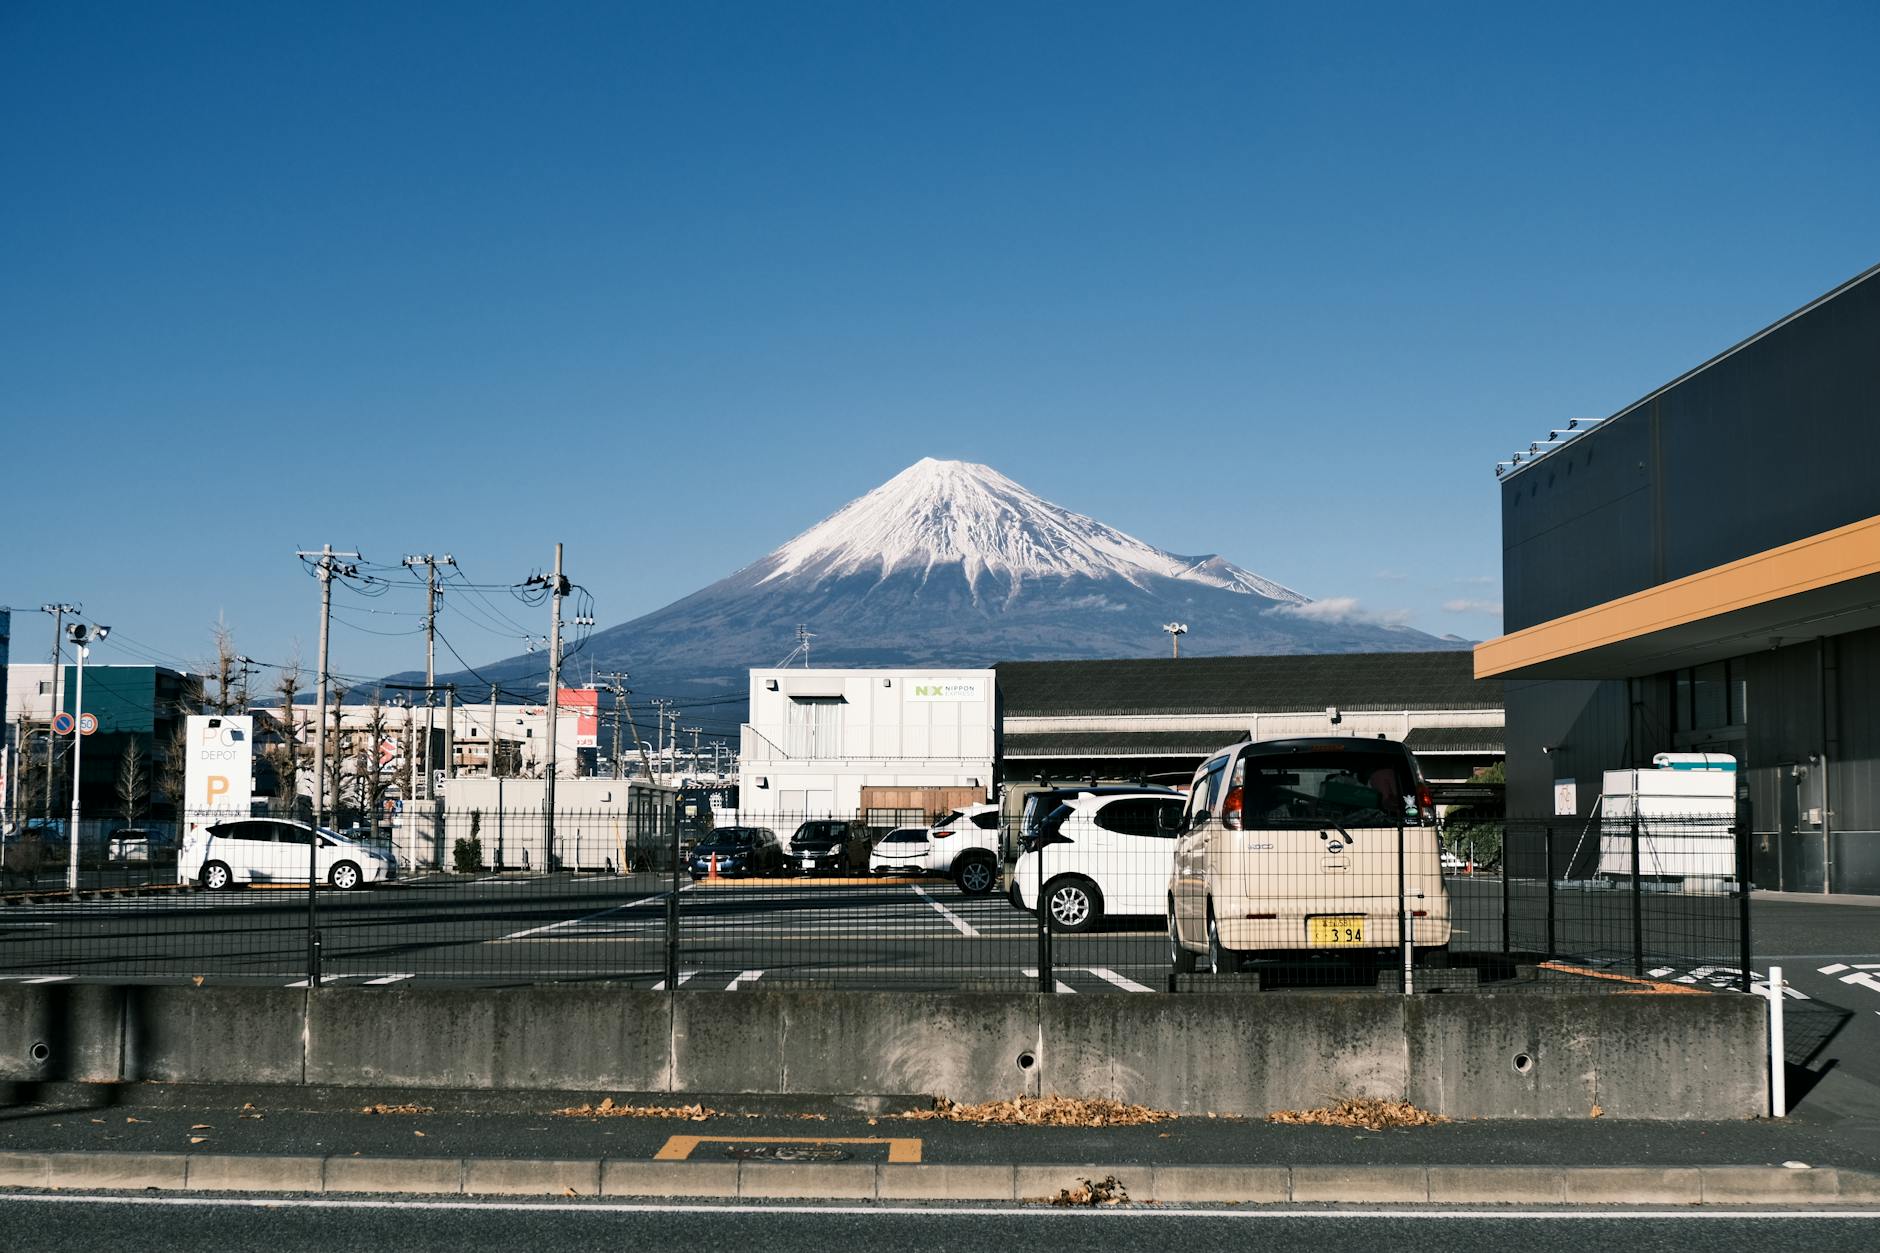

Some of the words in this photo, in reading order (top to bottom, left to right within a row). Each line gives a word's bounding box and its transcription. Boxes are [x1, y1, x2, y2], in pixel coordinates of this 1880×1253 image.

[80, 719, 92, 729] 50
[201, 751, 237, 760] DEPOT
[207, 775, 229, 805] P
